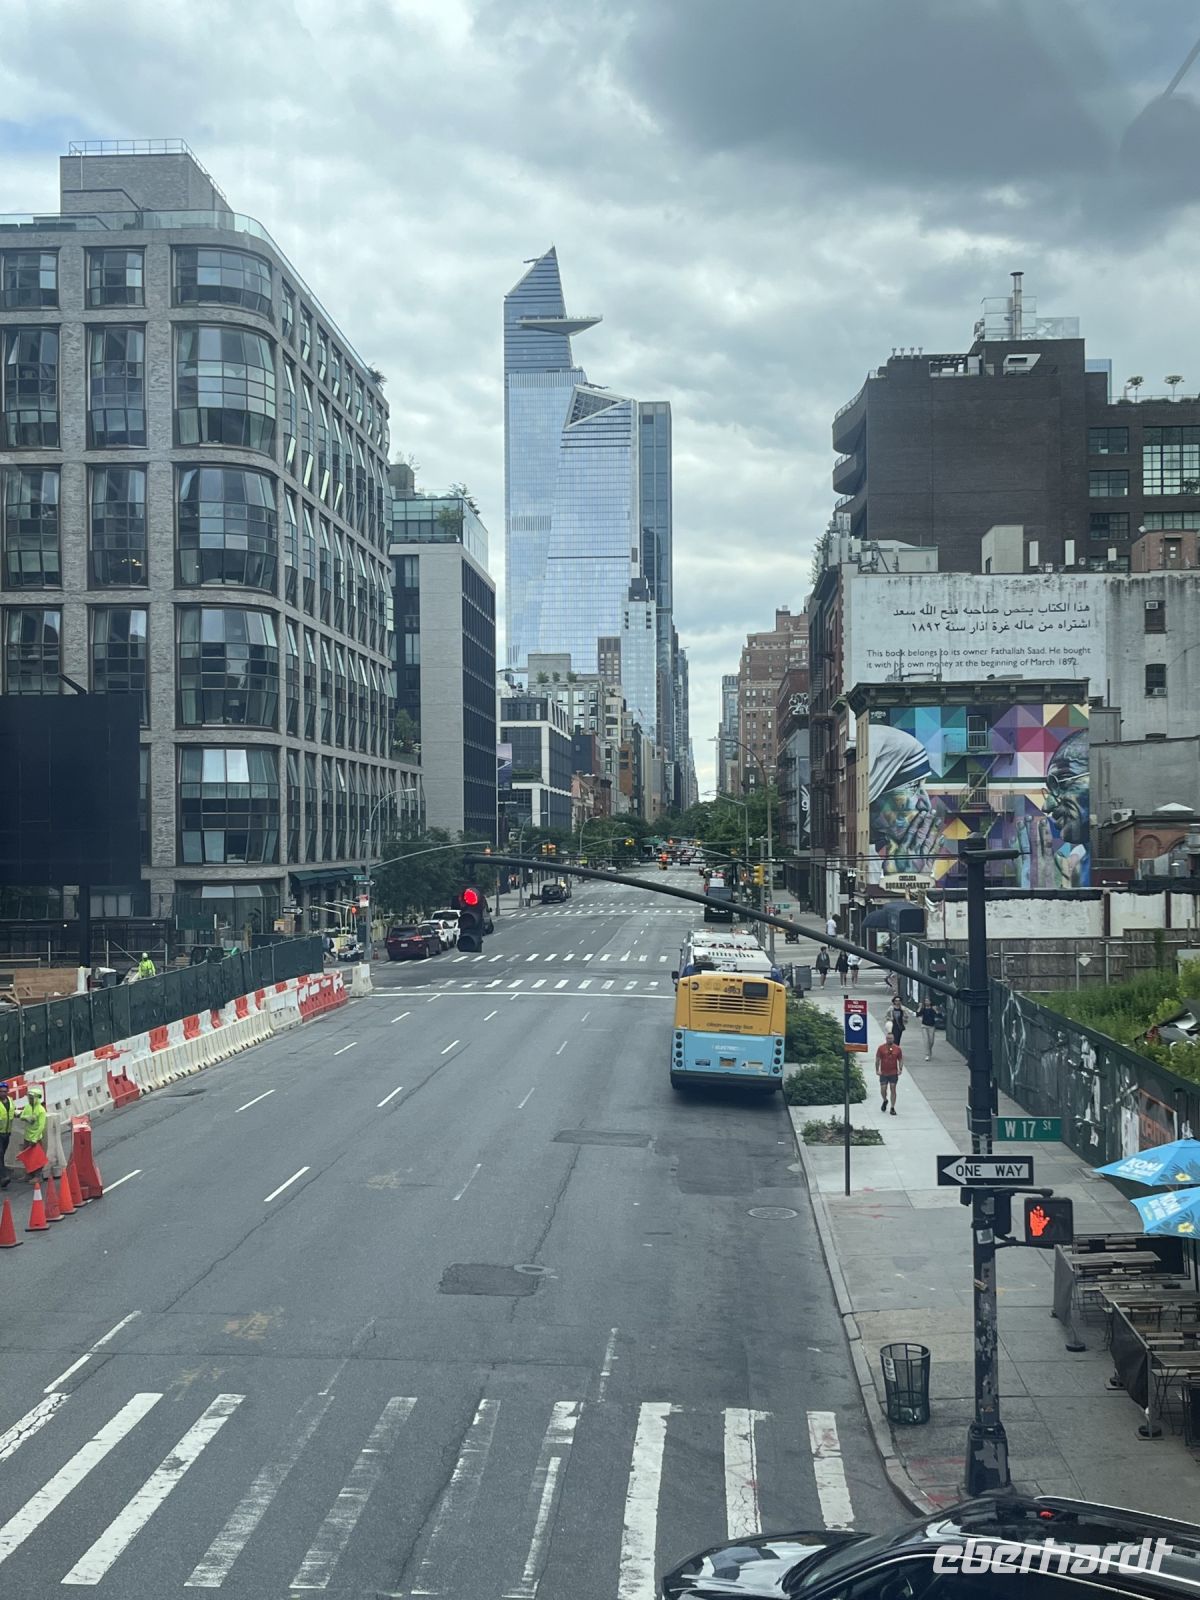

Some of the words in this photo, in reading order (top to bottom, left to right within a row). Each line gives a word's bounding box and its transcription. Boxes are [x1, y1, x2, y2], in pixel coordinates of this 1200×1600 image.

[893, 608, 916, 616] سعد
[919, 602, 936, 615] الله
[940, 605, 959, 619] فتح
[962, 605, 999, 617] صاحبه
[1037, 602, 1070, 616] الكتاب
[1073, 602, 1090, 612] هذا
[912, 622, 940, 632] ١٨٩٢
[945, 621, 966, 632] سنة
[991, 621, 1010, 633] غرة
[1014, 620, 1034, 630] ماله
[1038, 621, 1054, 632] من
[1057, 619, 1091, 631] اشتراه
[866, 649, 883, 657] This
[885, 648, 905, 657] book
[908, 649, 937, 658] belongs
[940, 648, 949, 656] to
[990, 647, 1025, 655] Fathallah
[1027, 646, 1046, 655] Saad.
[1048, 646, 1061, 654] He
[1063, 646, 1092, 656] bought
[866, 661, 872, 669] it
[874, 660, 892, 668] with
[965, 659, 979, 667] the
[980, 659, 1018, 669] beginning
[1019, 658, 1029, 666] of
[1030, 658, 1055, 666] March
[1004, 1120, 1016, 1138] W
[1022, 1120, 1036, 1138] 17
[955, 1164, 982, 1177] ONE
[994, 1164, 1024, 1177] WAY
